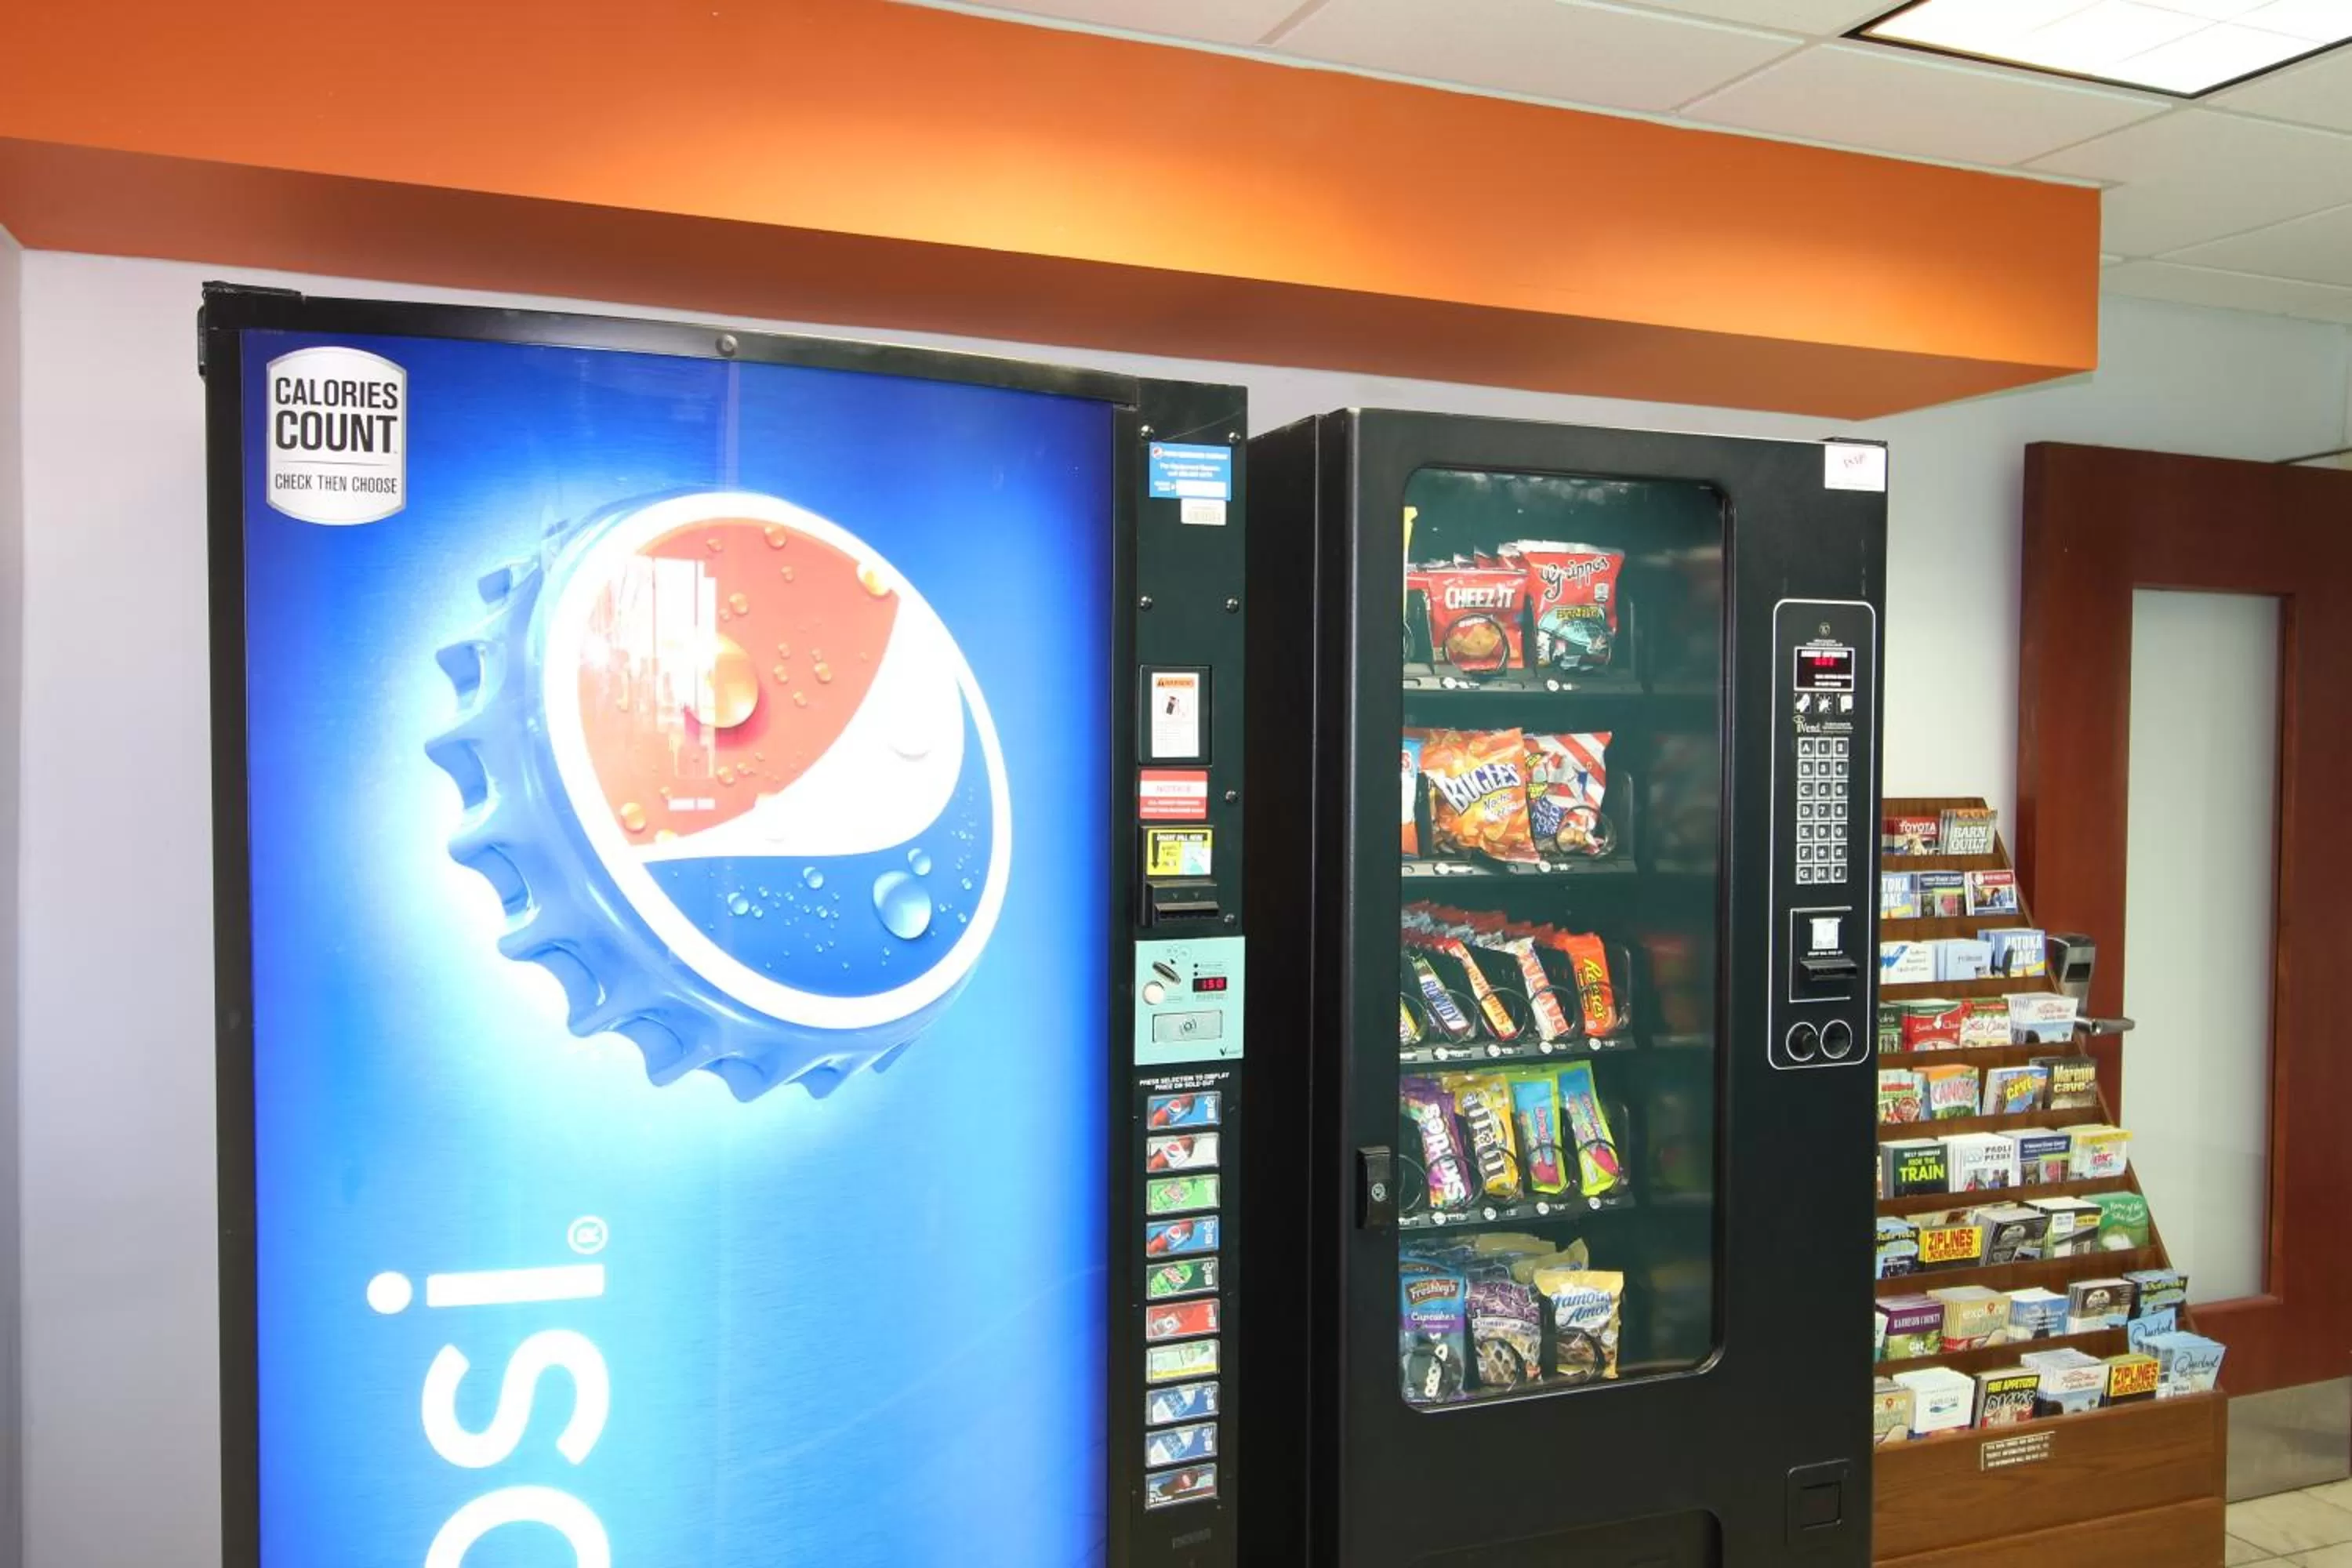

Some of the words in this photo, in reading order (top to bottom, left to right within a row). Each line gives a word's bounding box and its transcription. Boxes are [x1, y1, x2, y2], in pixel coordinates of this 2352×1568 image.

[275, 377, 398, 410] CALORIES
[275, 410, 397, 453] COUNT
[275, 473, 312, 490] CHECK
[318, 474, 347, 492] THEN
[352, 477, 397, 494] CHOOSE
[1900, 821, 1936, 833] TOYOTA
[1955, 826, 1986, 838] BARN
[1951, 839, 1987, 851] QUILT
[1882, 877, 1908, 892] TOKA
[1882, 894, 1901, 907] AKE
[2013, 950, 2036, 965] LAKE
[1899, 1163, 1944, 1182] TRAIN
[1927, 1229, 1973, 1250] ZIPLINES
[1411, 1310, 1456, 1322] Cupcakes
